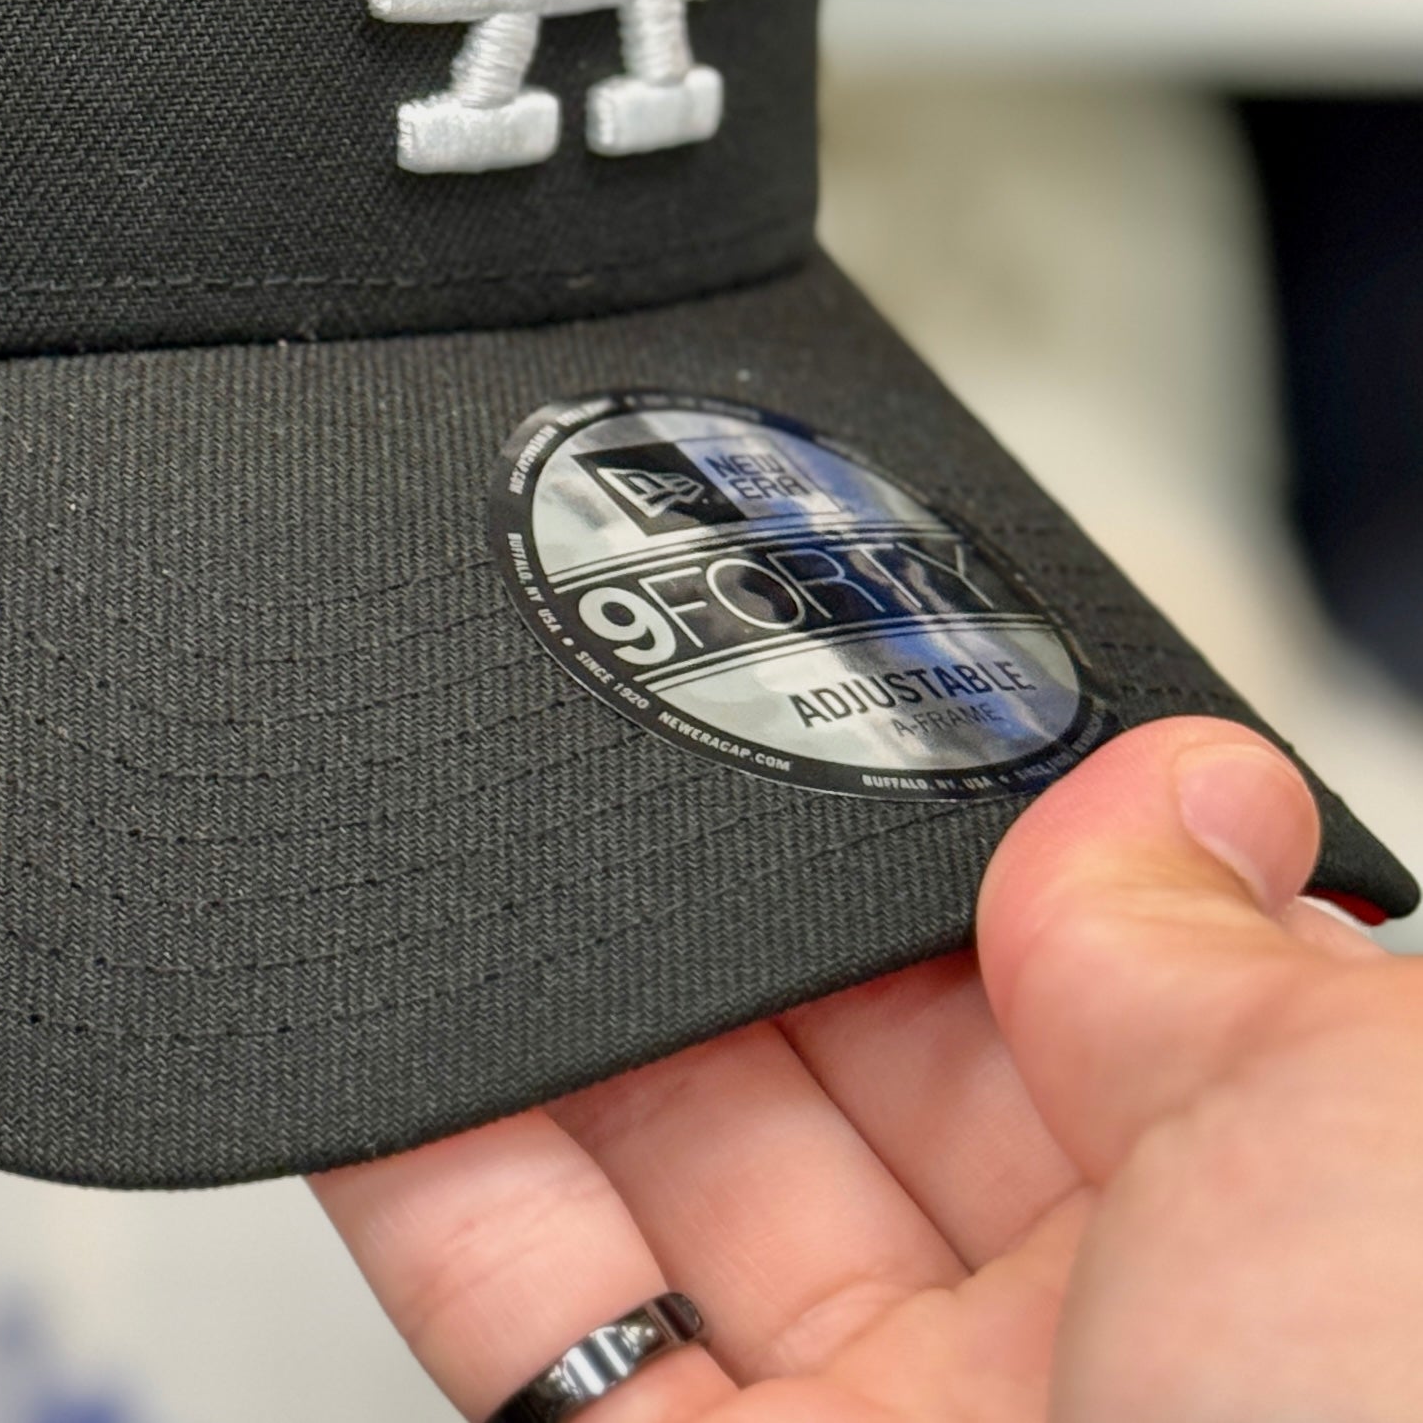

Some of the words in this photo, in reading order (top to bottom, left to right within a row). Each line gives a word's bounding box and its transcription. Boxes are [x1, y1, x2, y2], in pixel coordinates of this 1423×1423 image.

[705, 453, 785, 478] NEW
[727, 477, 810, 500] ERA
[578, 541, 996, 666] 9FORTY
[524, 586, 546, 603] NY
[537, 608, 563, 633] USA
[575, 650, 615, 684] SINCE
[612, 681, 651, 710] 1920
[657, 711, 791, 771] NEWERACAP.COM
[966, 776, 993, 790] USA
[787, 660, 1037, 728] ADJUSTABLE
[890, 702, 1005, 737] A-FRAME
